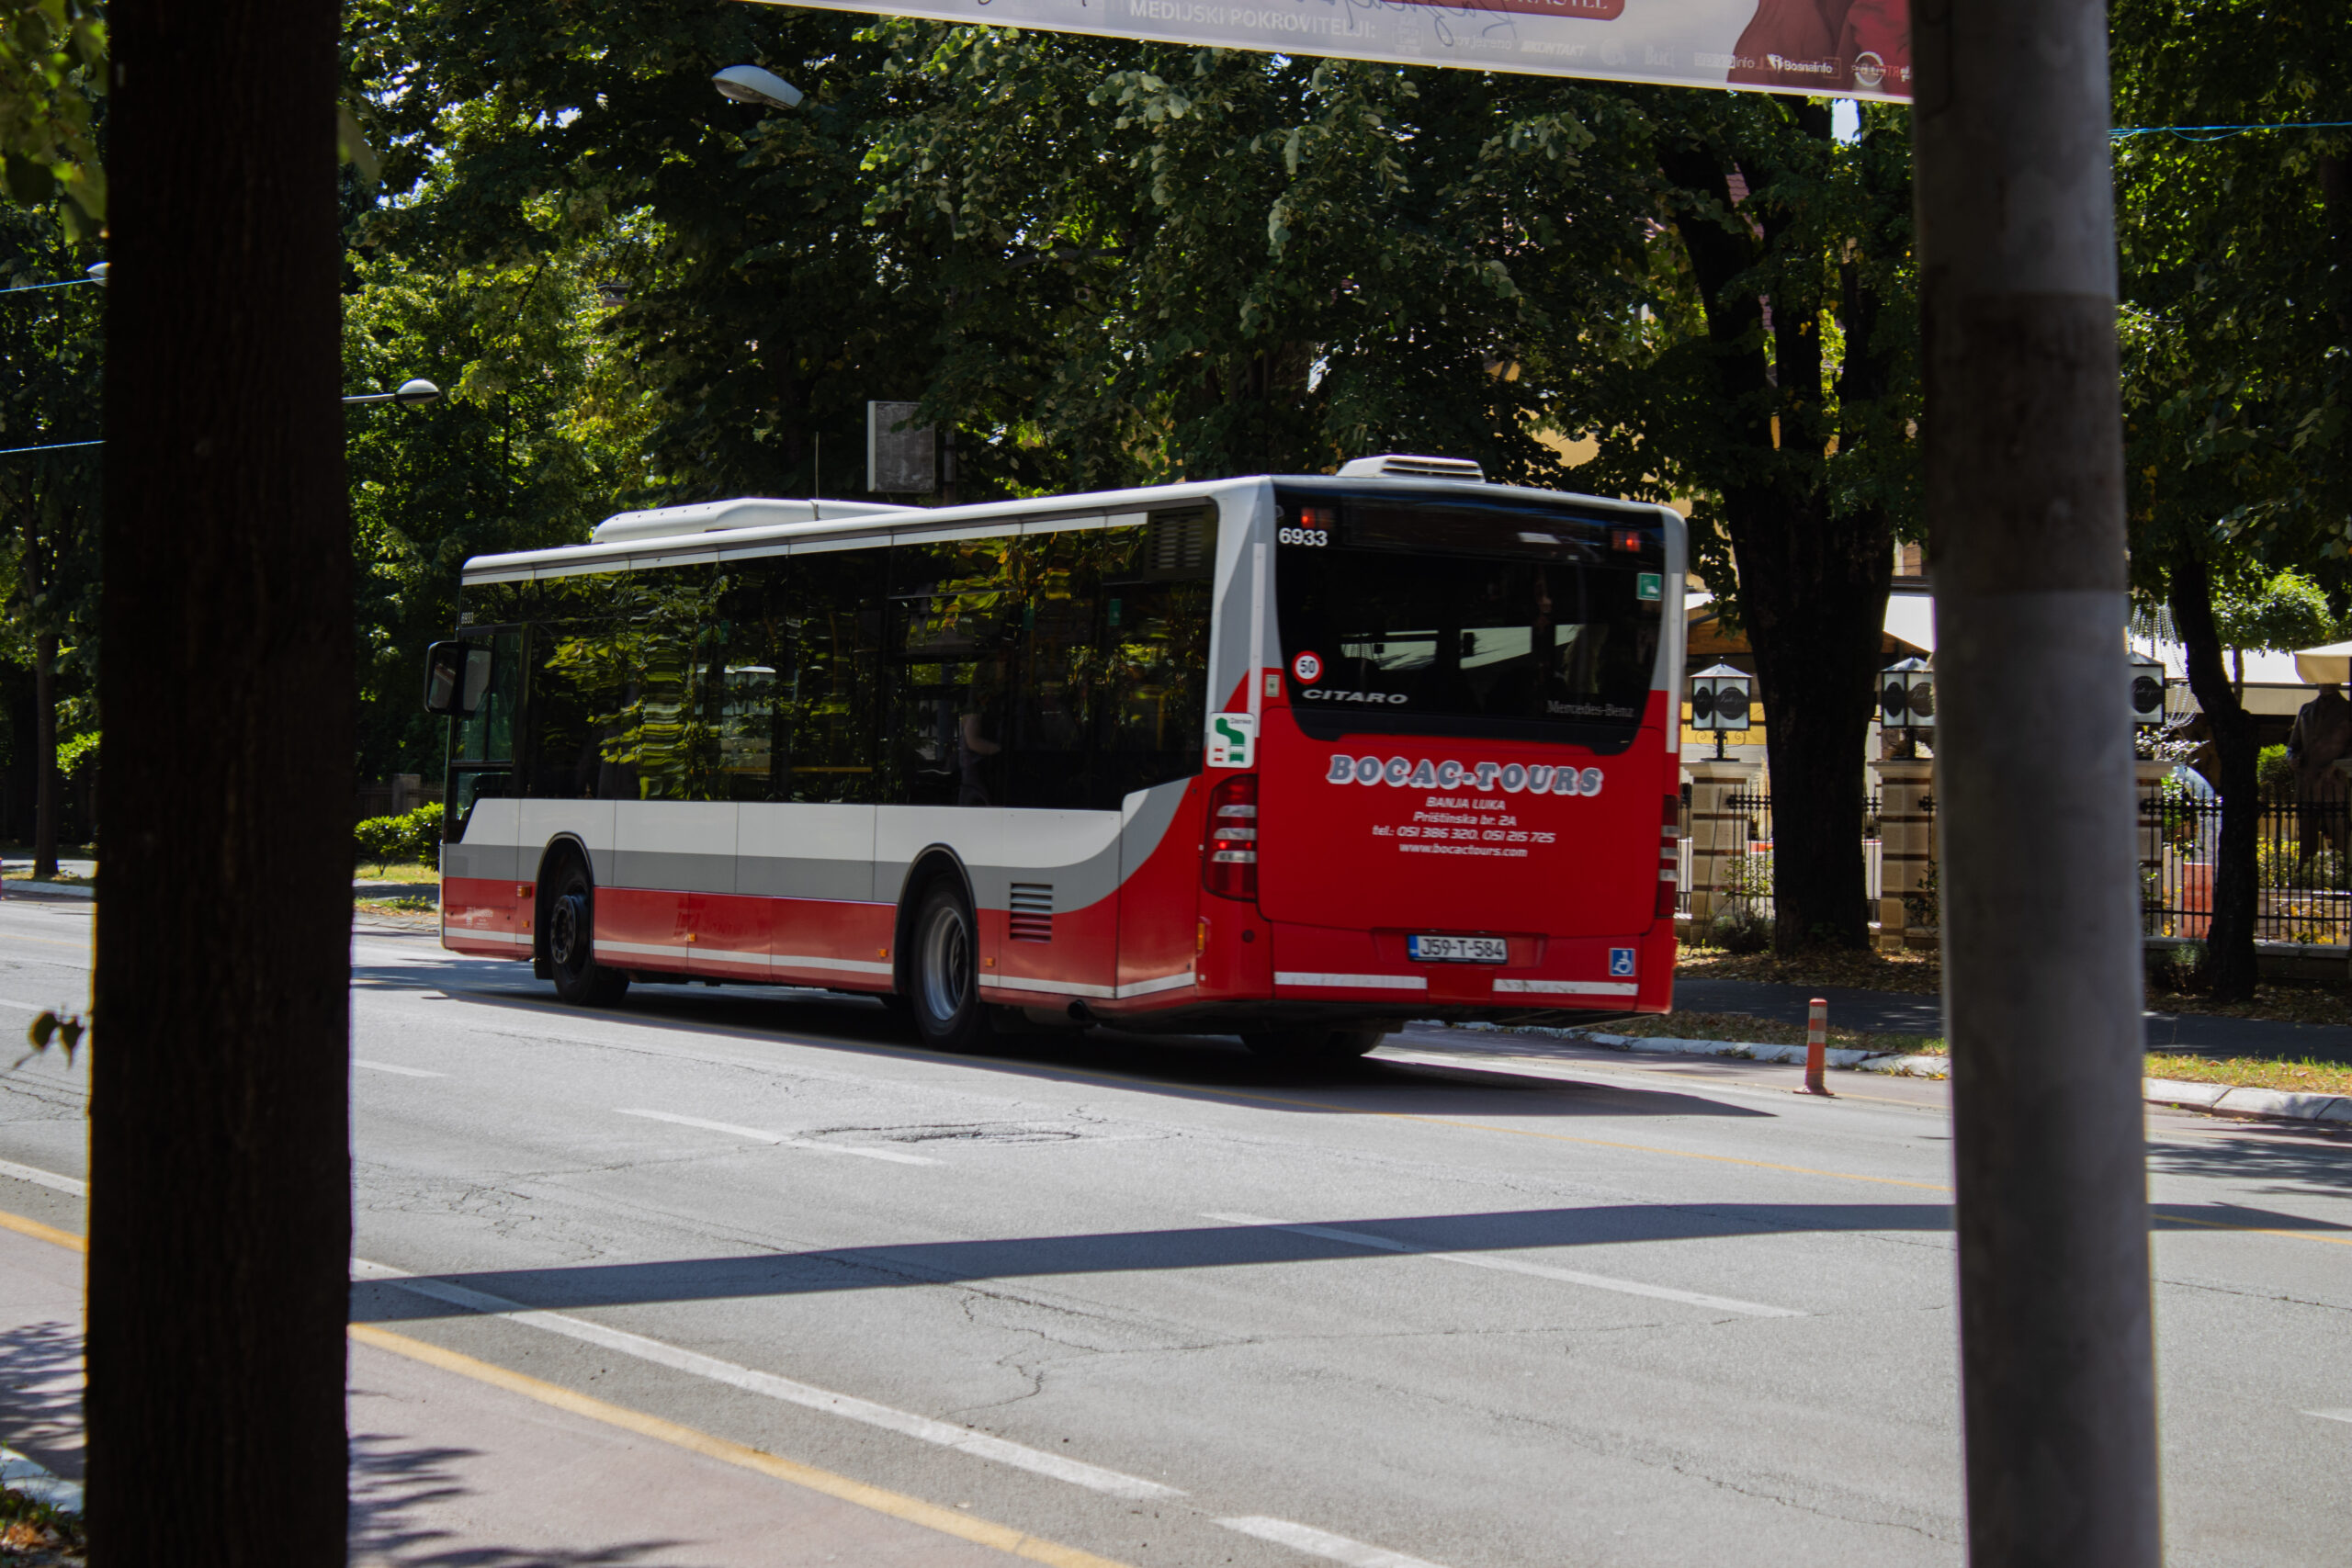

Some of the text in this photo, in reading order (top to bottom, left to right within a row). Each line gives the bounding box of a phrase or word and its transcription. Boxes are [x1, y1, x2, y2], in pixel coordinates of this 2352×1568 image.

[1130, 0, 1225, 26] MEDIJSKI
[1229, 8, 1376, 39] POKROVITELJI:
[1279, 527, 1329, 547] 6933
[1300, 660, 1316, 673] 50
[1302, 689, 1408, 704] CITARO
[1426, 796, 1506, 810] BANJA LUKA
[1498, 816, 1517, 826] 2A
[1396, 826, 1420, 838] 051
[1420, 827, 1450, 839] 386
[1482, 829, 1506, 841] 051
[1506, 831, 1529, 842] 215
[1529, 831, 1556, 843] 725
[1399, 842, 1528, 858] www.bocactours.com
[1421, 938, 1504, 958] J59-T-584
